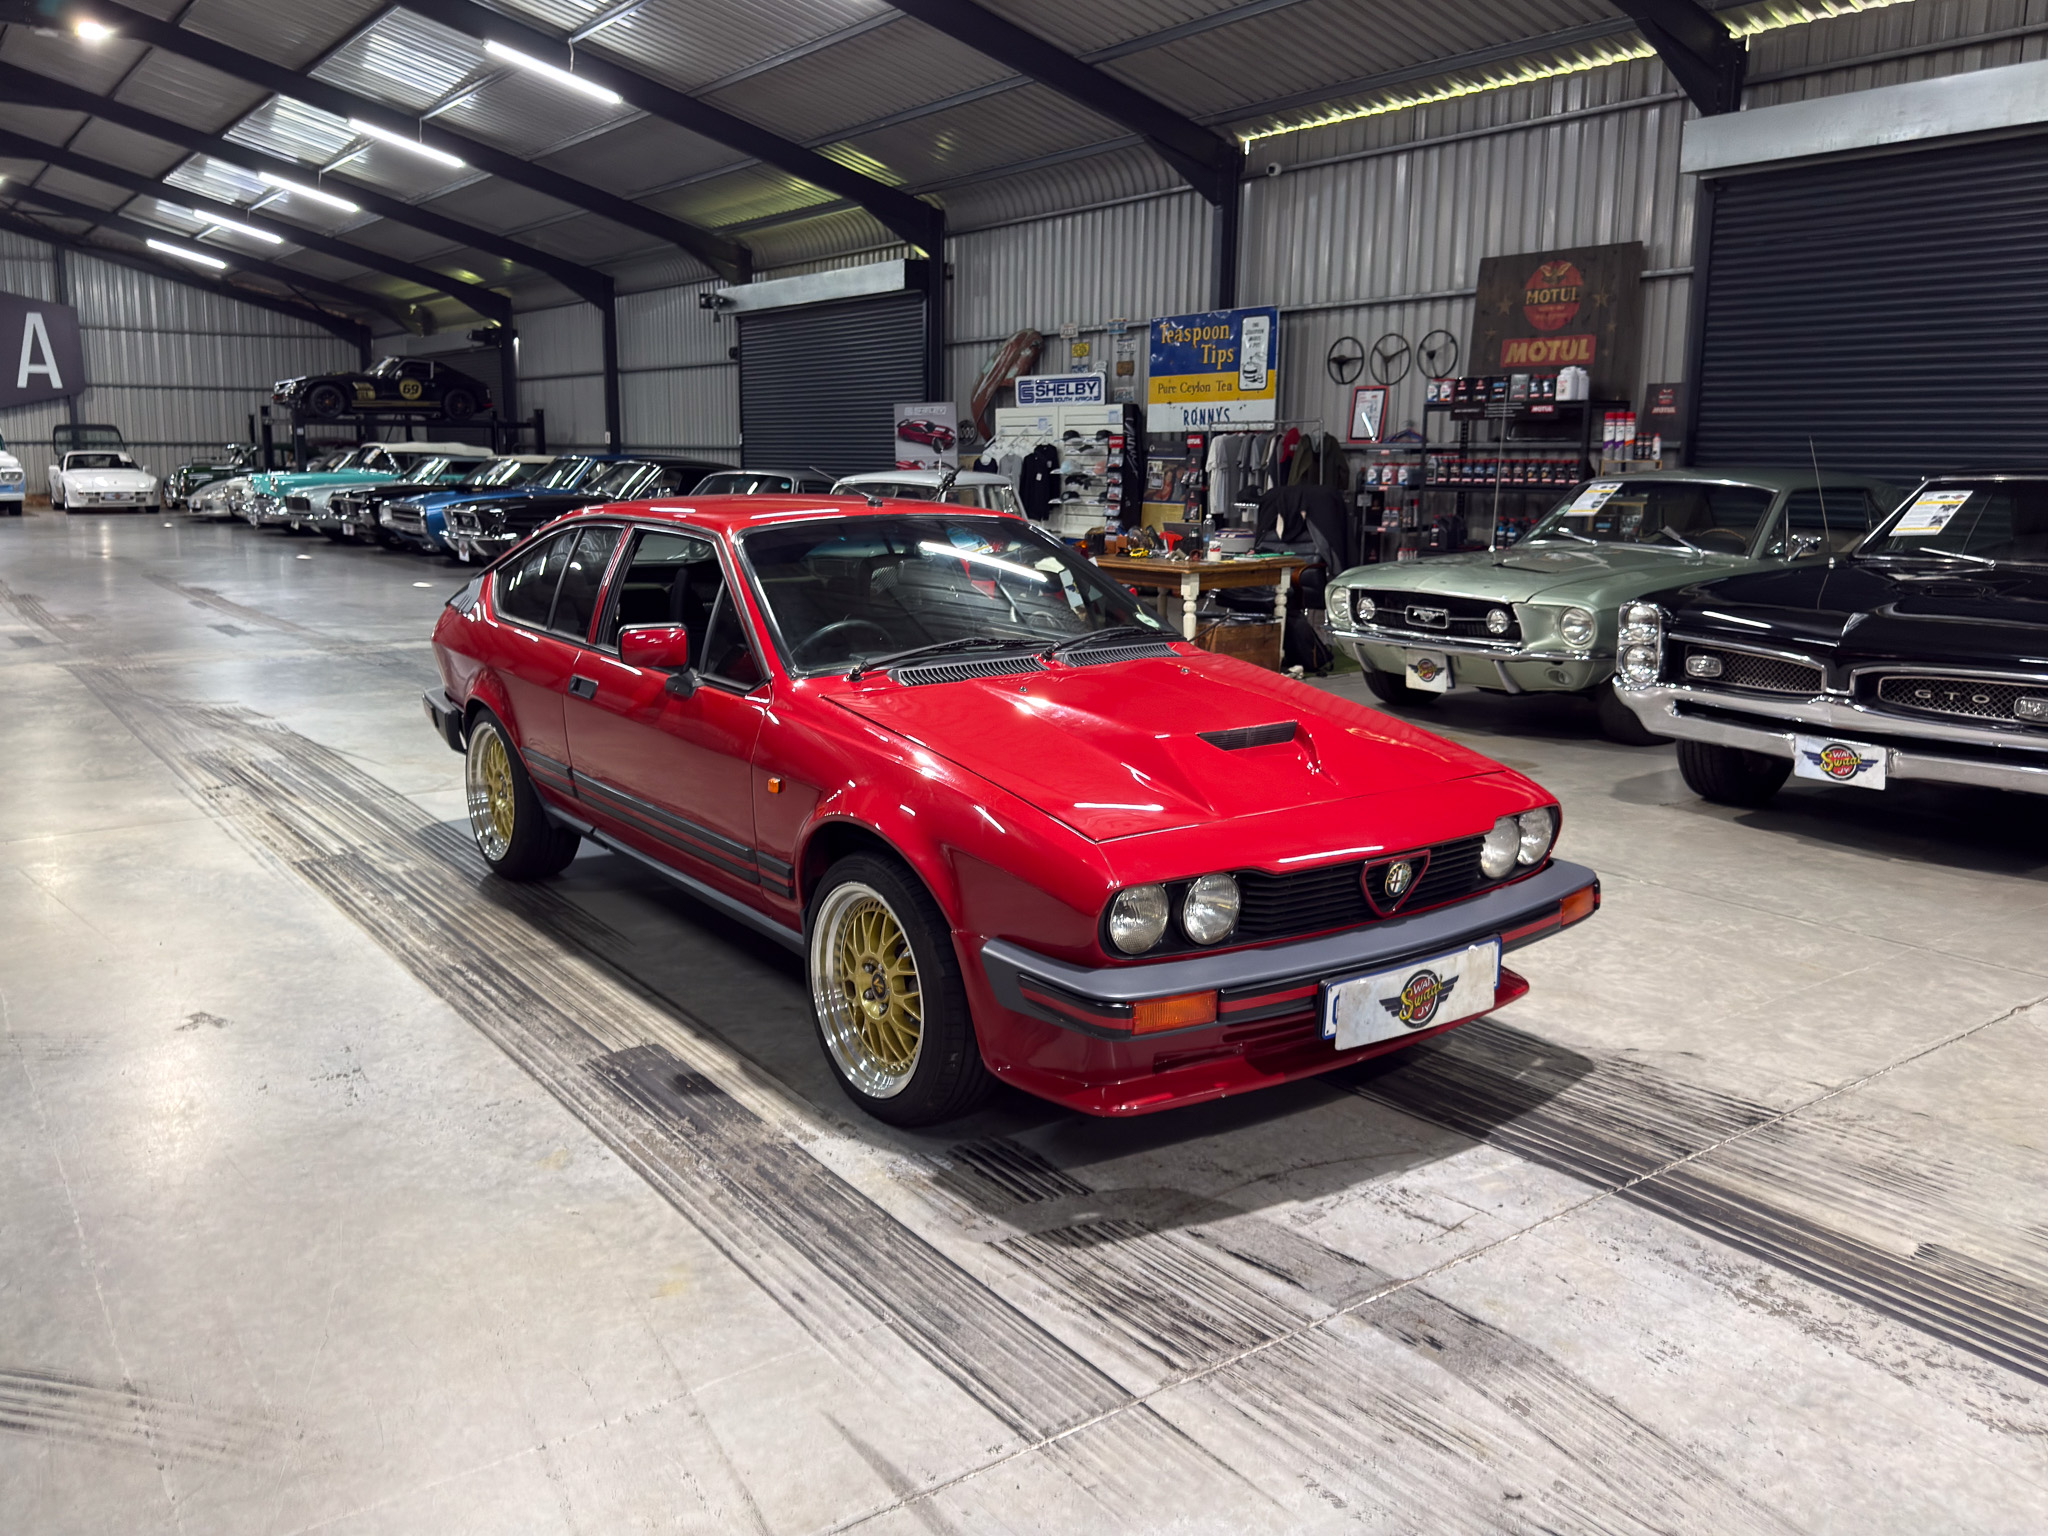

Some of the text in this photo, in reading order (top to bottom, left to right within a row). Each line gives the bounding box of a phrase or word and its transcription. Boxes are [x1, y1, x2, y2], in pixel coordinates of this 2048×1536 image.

[1526, 286, 1577, 305] MOTUL
[1160, 324, 1230, 348] Teaspoon
[17, 312, 63, 389] A
[1201, 344, 1235, 370] Tips
[1505, 338, 1590, 364] MOTUL
[403, 384, 419, 395] 69
[1035, 382, 1097, 397] SHELBY
[1158, 380, 1232, 395] Pure Ceylon Tea
[1183, 407, 1230, 425] RONNYS
[1532, 405, 1553, 413] MOTUL
[1915, 689, 1990, 704] GTO
[1821, 752, 1862, 772] Swaai
[1399, 974, 1444, 1020] Swaai
[1418, 1003, 1431, 1017] JY
